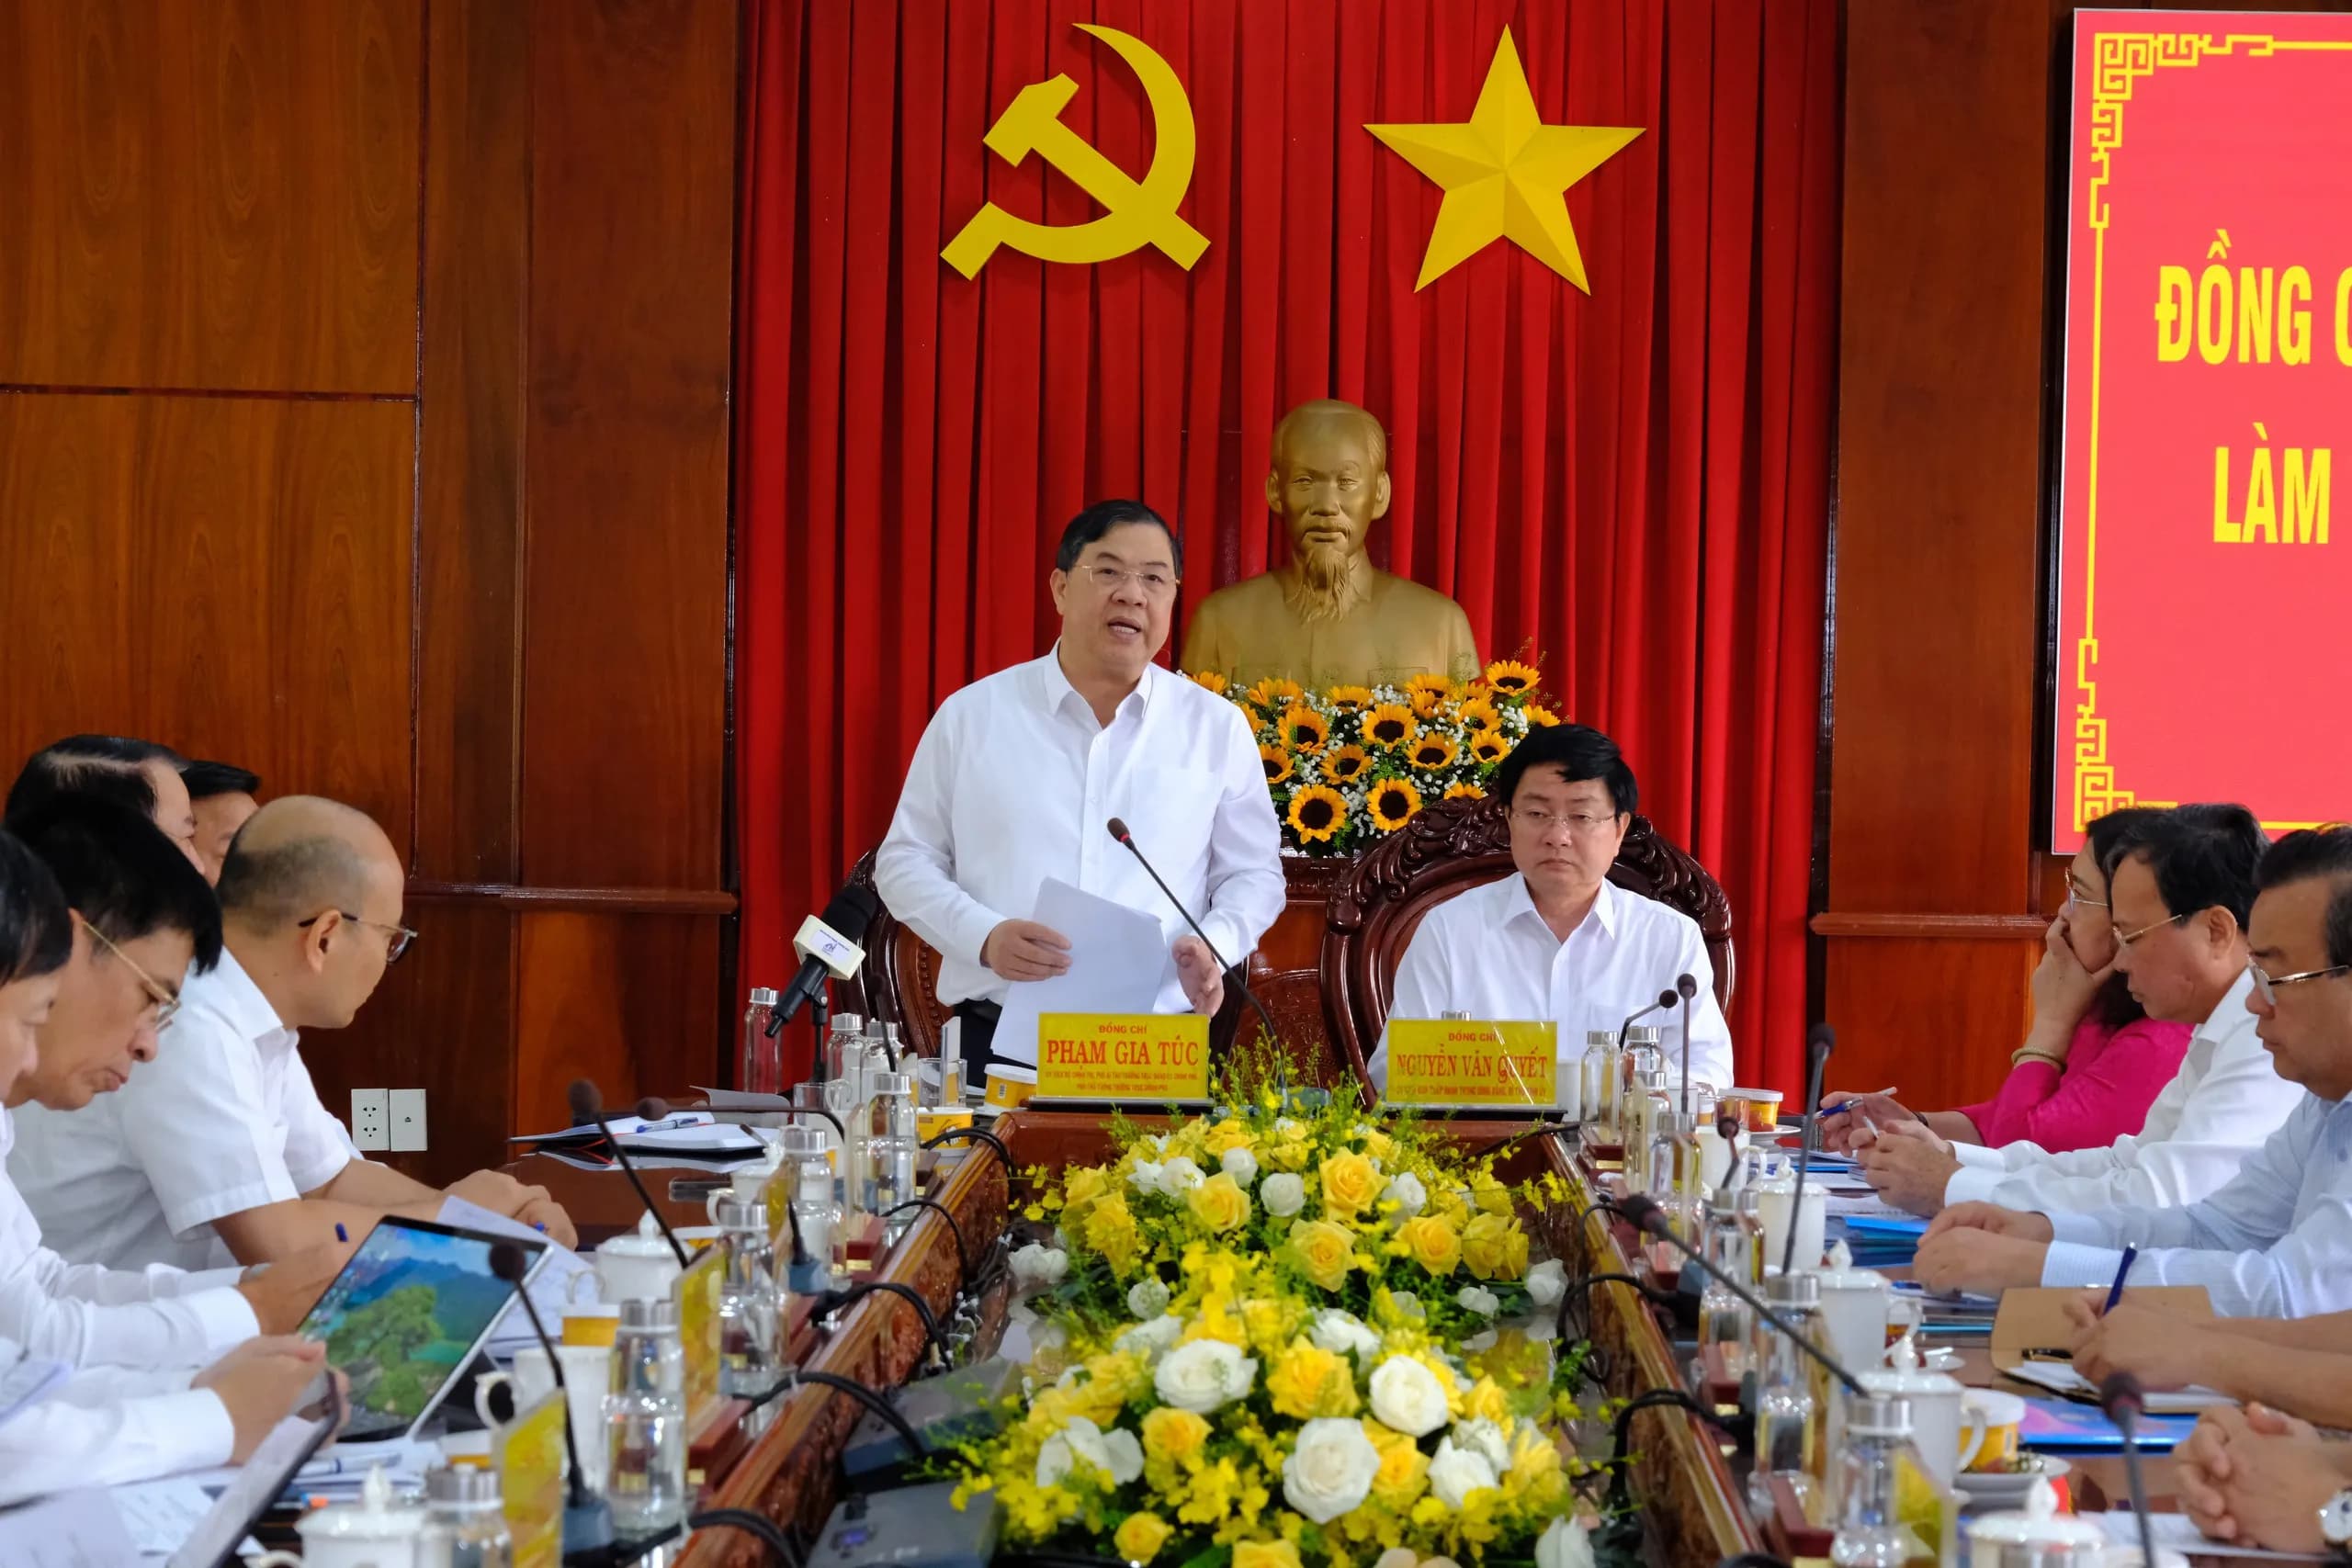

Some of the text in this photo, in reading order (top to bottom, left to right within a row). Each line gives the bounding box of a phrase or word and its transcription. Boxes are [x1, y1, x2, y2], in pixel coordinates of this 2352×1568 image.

[2154, 228, 2312, 366] ĐỒNG
[2213, 422, 2332, 544] LÀM
[1046, 1034, 1199, 1070] PHẠM GIA TÚC
[1396, 1043, 1548, 1084] NGUYỄN VĂN QUYẾT
